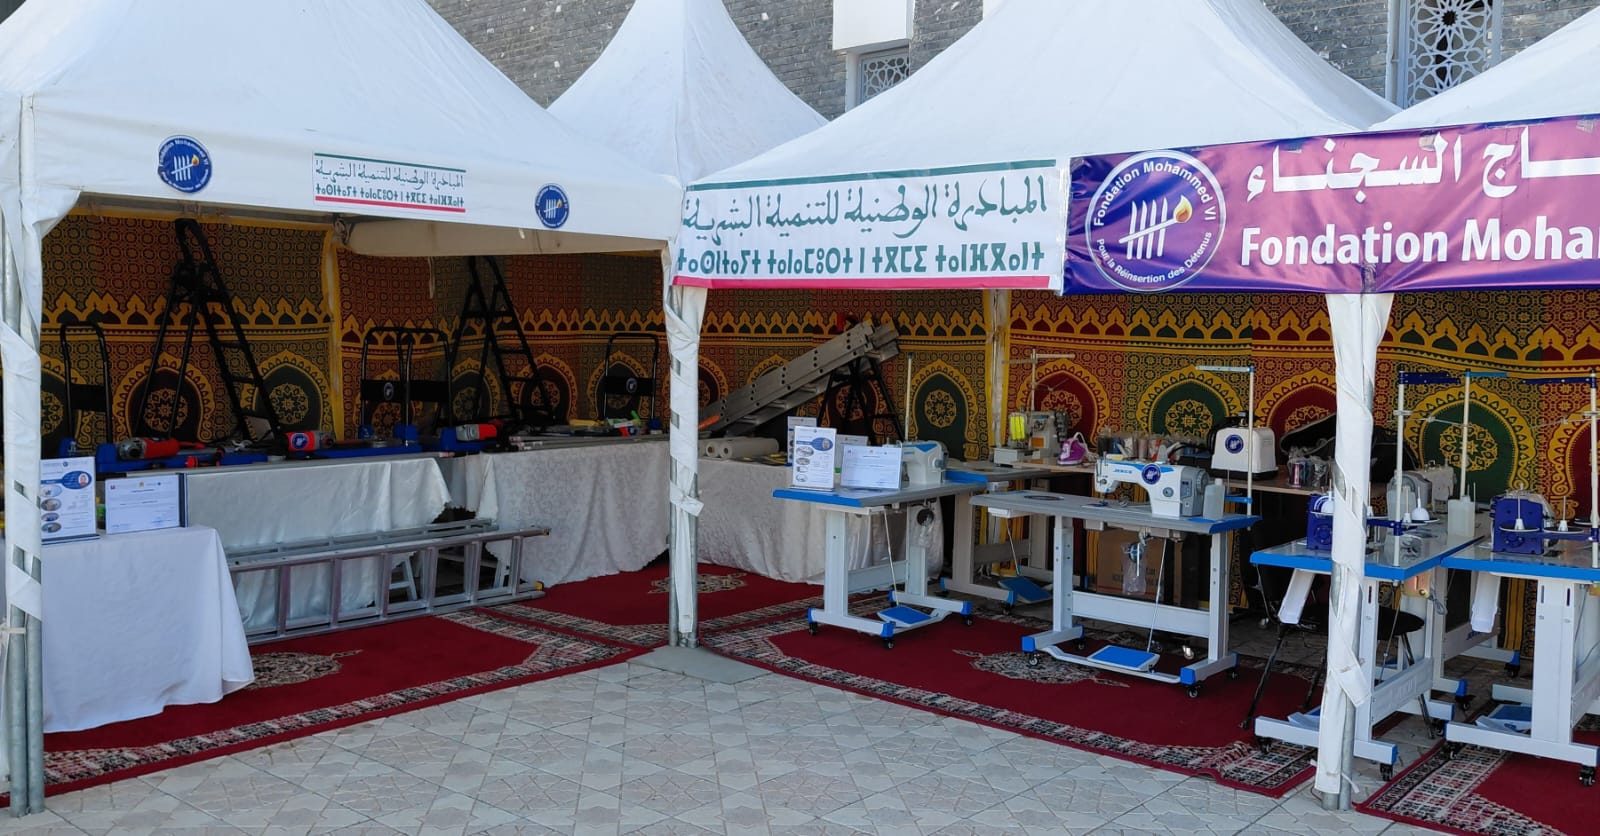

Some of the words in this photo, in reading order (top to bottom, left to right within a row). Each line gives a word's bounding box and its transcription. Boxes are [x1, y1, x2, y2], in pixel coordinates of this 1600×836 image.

[316, 160, 355, 183] البشرية
[358, 164, 390, 183] للتنمية
[393, 167, 428, 190] الوطنية
[430, 171, 464, 190] المبادرة
[1247, 132, 1461, 203] السجناء
[1483, 125, 1600, 198] اج
[765, 189, 839, 238] للتنمية
[844, 183, 937, 239] الوطنية
[945, 175, 1047, 231] المبادرة
[1094, 167, 1140, 226] Fondation
[1143, 161, 1213, 203] Mohammed
[1204, 205, 1216, 220] VI
[683, 194, 762, 246] البشرية
[1241, 221, 1448, 266] Fondation
[1461, 215, 1600, 262] Moha
[1097, 238, 1110, 261] Pour
[1106, 259, 1115, 268] la
[1114, 266, 1165, 283] Réinsertion
[1167, 267, 1185, 278] des
[1184, 231, 1212, 268] Détenus
